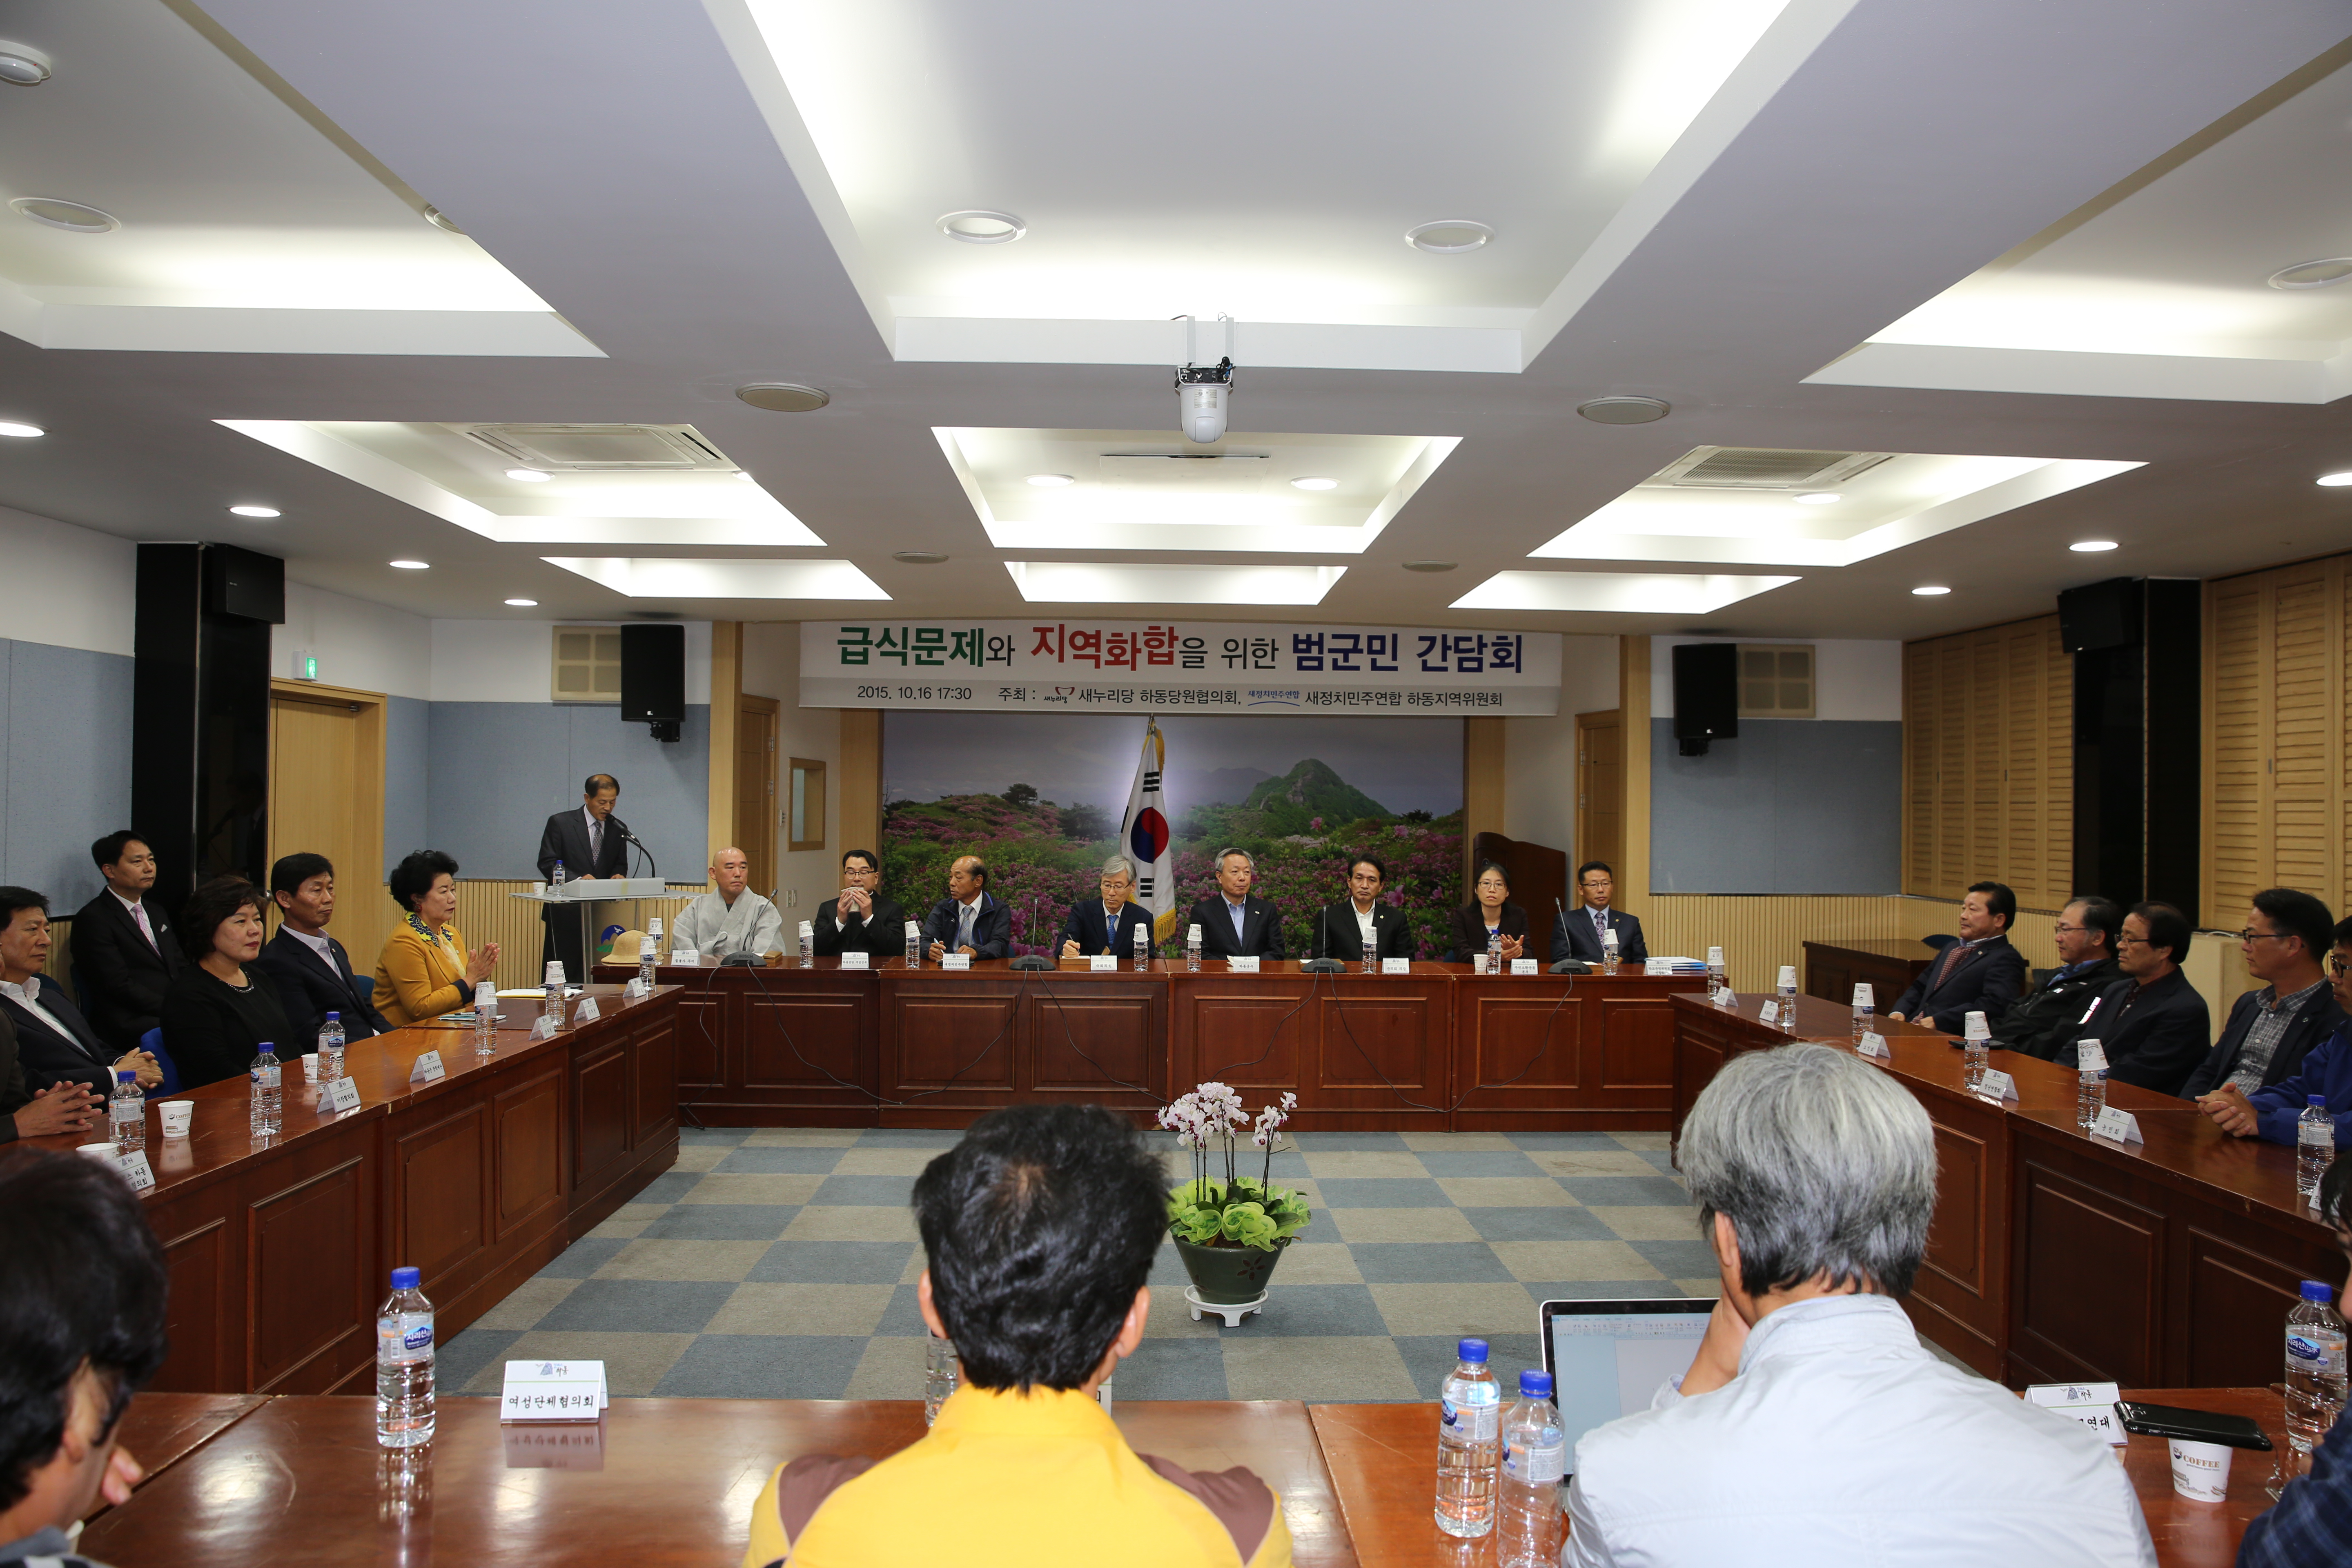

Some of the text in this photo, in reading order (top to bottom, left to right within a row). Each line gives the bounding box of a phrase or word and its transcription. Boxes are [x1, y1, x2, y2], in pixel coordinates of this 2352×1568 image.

[837, 624, 1522, 673] 급식문제와 지역화합을 위한 범군민 간담회
[857, 686, 892, 699] 2015.
[898, 686, 932, 700] 10.16
[937, 687, 972, 700] 17:30
[998, 687, 1026, 702] 주최
[1043, 695, 1068, 704] 새누리당
[1078, 688, 1135, 704] 새누리당
[1140, 689, 1241, 706] 하동당원협의회,
[1247, 690, 1300, 699] 새정치민주연합
[1305, 691, 1402, 706] 새정치민주연합
[1407, 692, 1502, 707] 하동지역위원회
[337, 1092, 355, 1103] 이장협의회
[135, 1167, 146, 1177] 하동
[509, 1395, 594, 1409] 여성단체협의회
[2183, 1454, 2221, 1468] COFFEE
